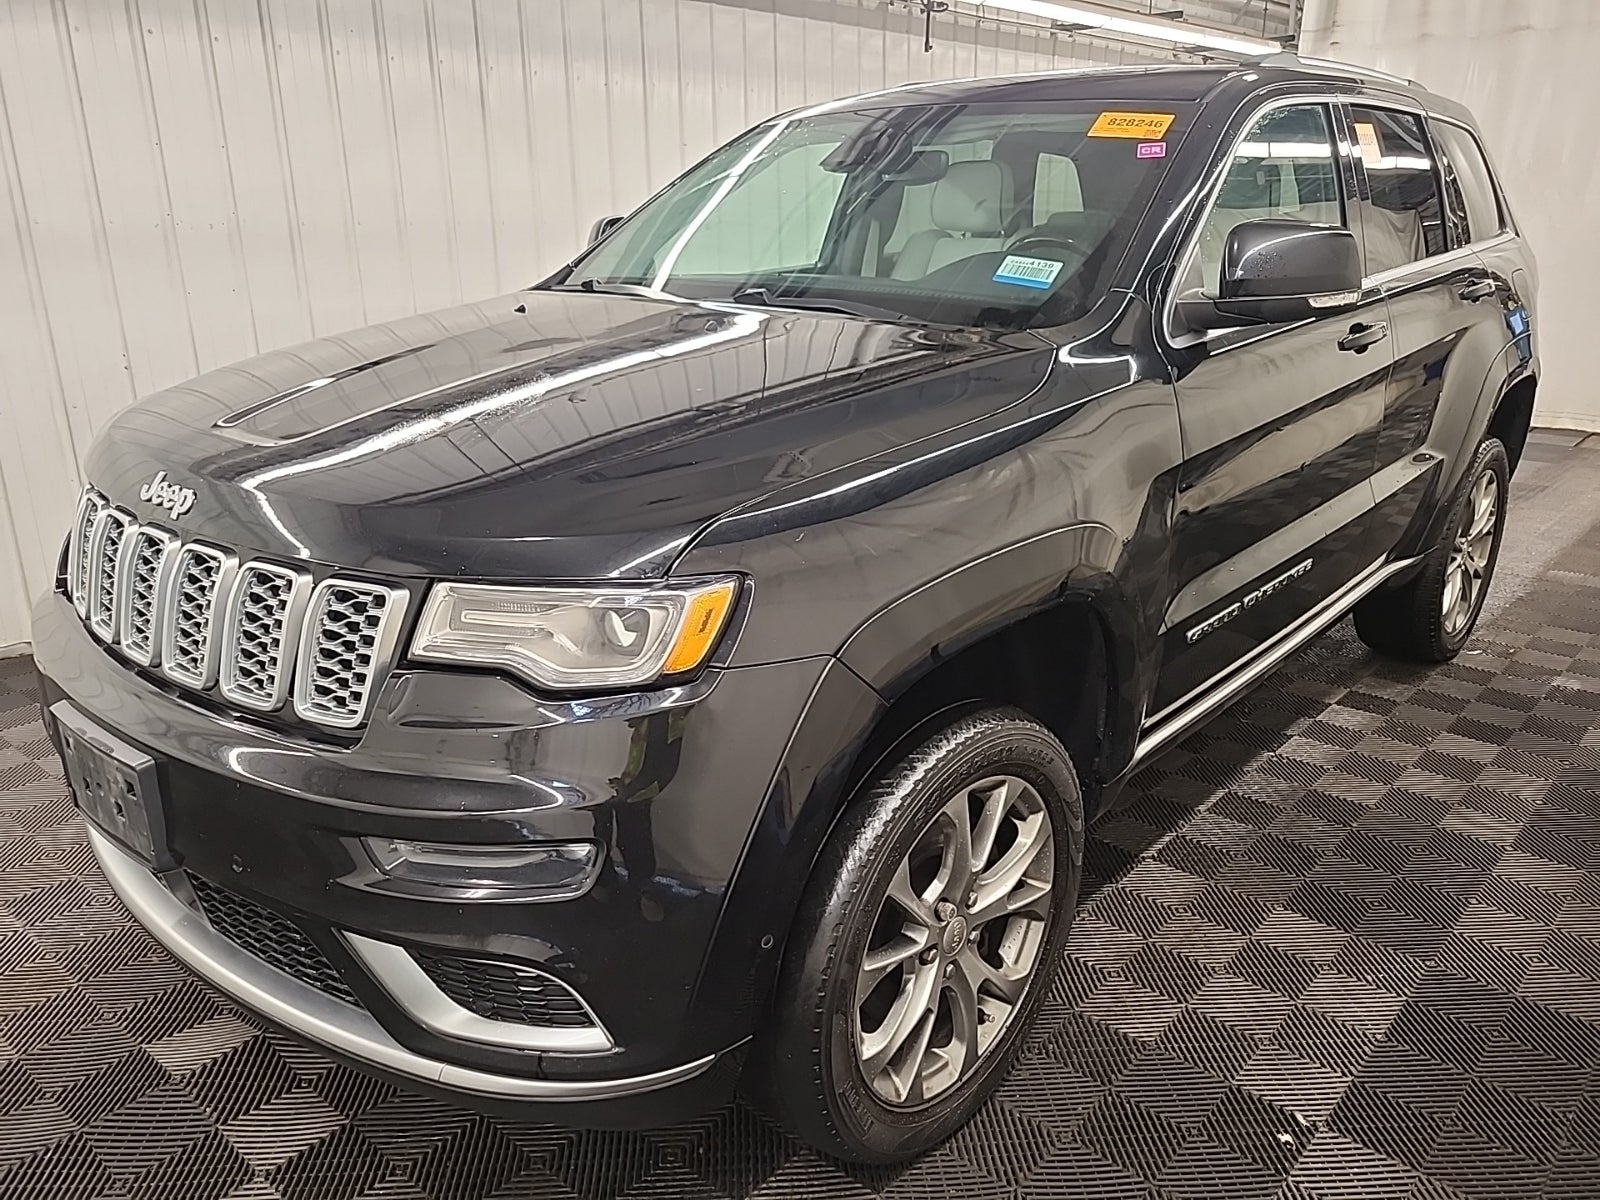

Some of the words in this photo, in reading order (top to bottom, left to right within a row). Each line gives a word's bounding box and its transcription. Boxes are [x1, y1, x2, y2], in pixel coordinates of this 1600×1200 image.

[1107, 117, 1165, 128] 828246
[1141, 146, 1162, 154] CR
[140, 470, 197, 521] Jeep
